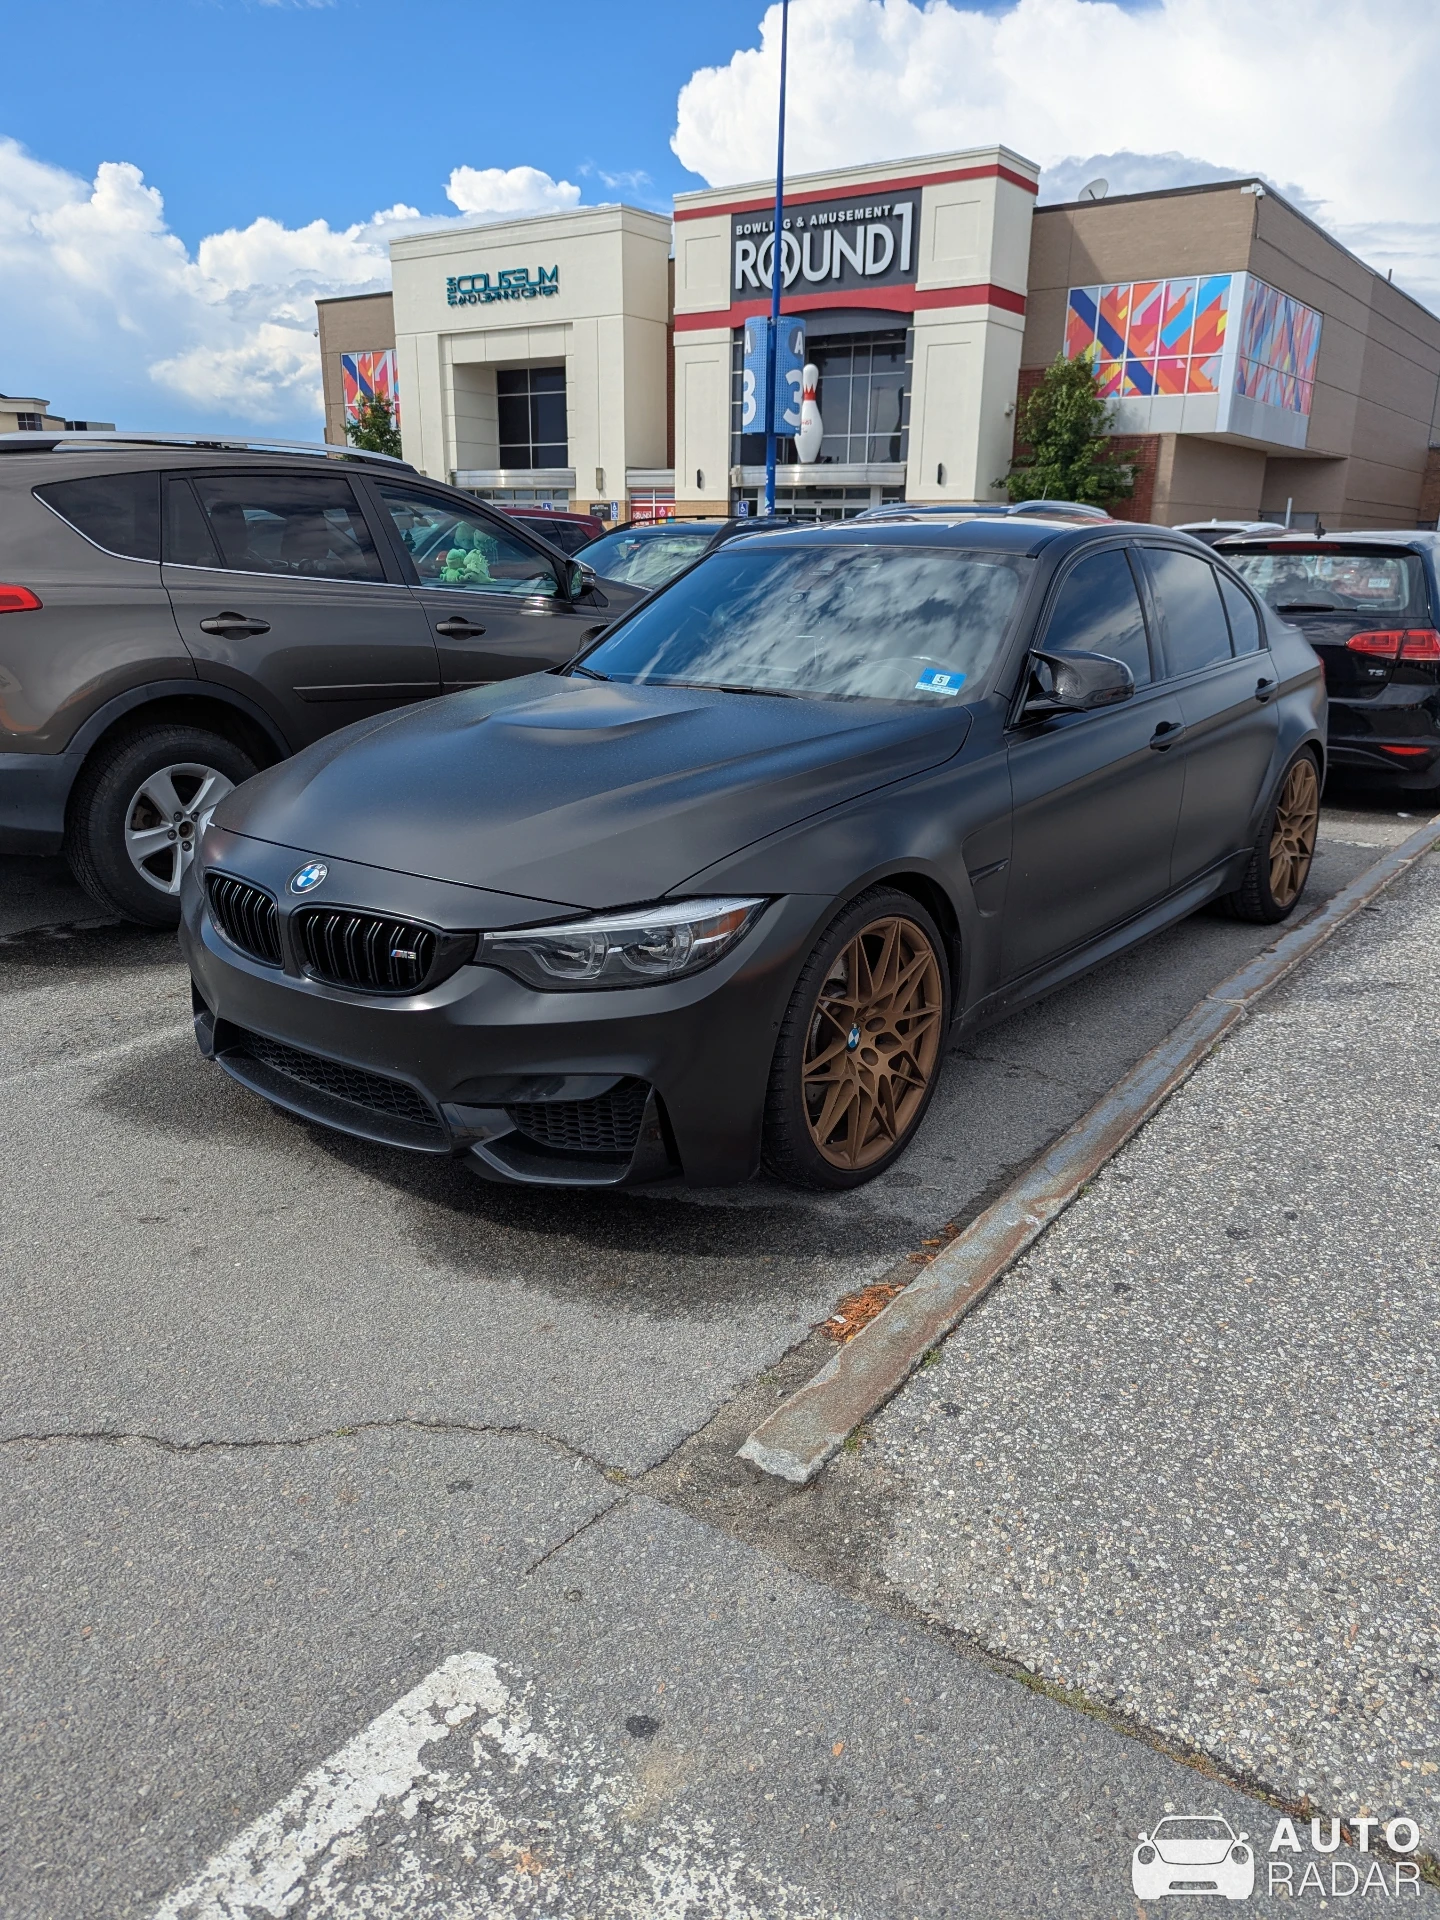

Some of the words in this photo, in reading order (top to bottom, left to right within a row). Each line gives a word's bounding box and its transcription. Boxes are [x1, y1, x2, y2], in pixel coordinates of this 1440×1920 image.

[736, 219, 791, 236] BOWLIG
[796, 217, 805, 227] &
[810, 205, 891, 226] AMUSEMENT
[735, 202, 913, 290] ROUND1
[446, 276, 458, 306] STEM
[457, 265, 558, 294] COLISEUM
[458, 293, 477, 305] AND
[744, 330, 751, 354] A
[794, 331, 804, 355] A
[783, 369, 803, 427] 3
